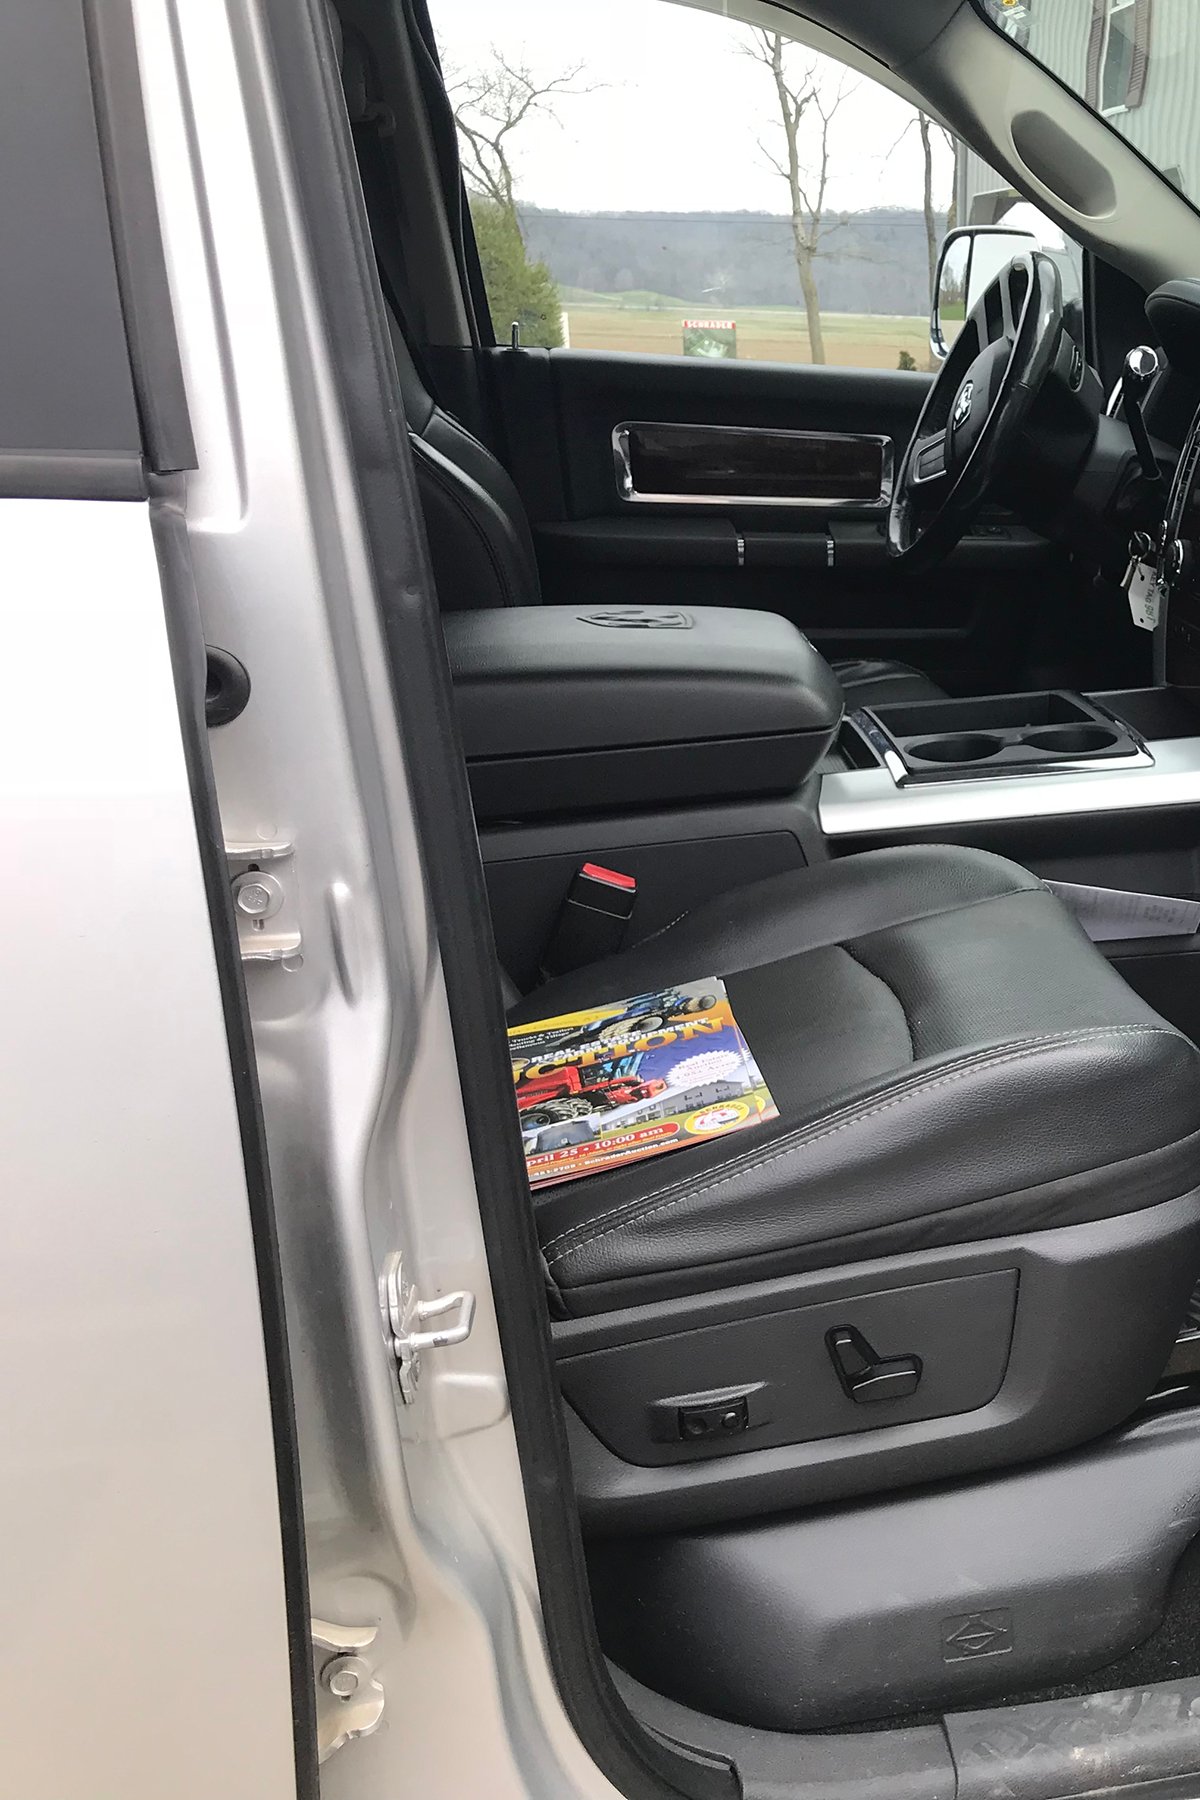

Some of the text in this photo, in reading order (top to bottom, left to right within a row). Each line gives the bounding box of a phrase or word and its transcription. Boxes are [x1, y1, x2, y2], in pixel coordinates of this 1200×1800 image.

[560, 1147, 579, 1158] 25
[594, 1133, 636, 1151] 10:00
[638, 1127, 664, 1139] am
